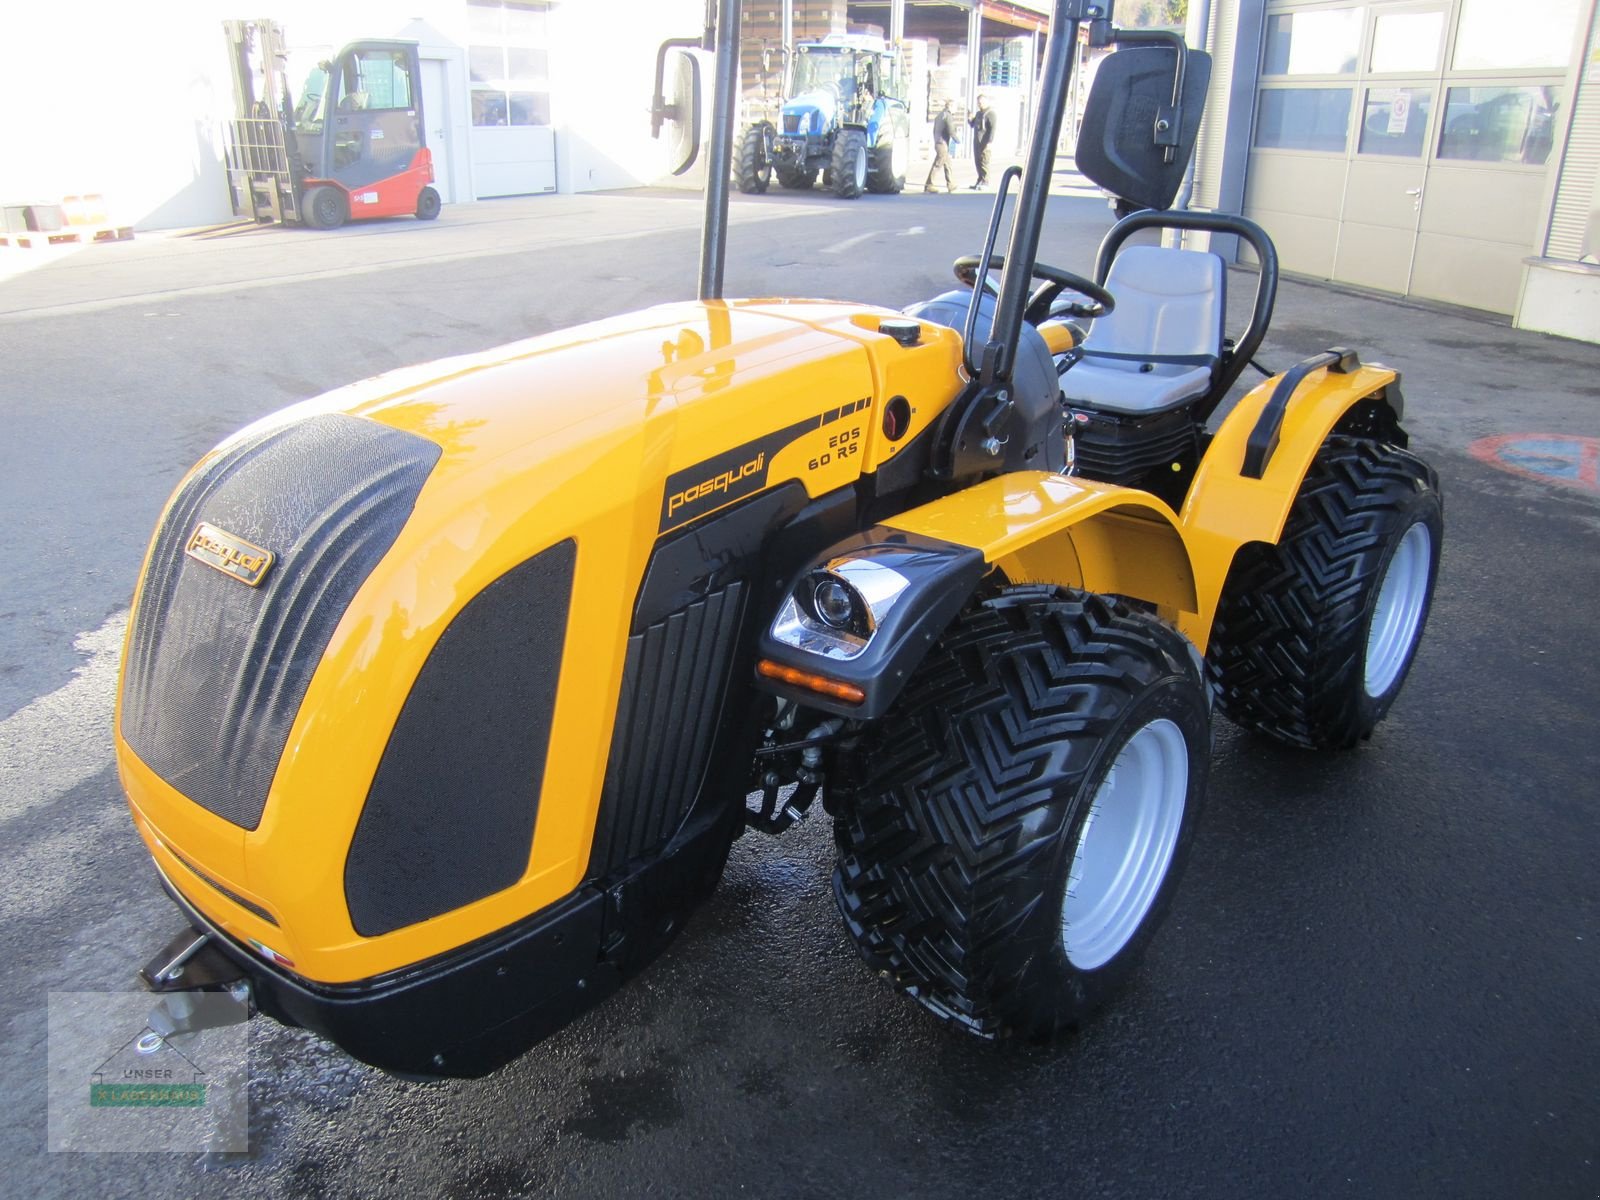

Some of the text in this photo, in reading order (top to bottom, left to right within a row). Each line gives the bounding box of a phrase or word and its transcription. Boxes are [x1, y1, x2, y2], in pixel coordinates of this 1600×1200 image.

[829, 427, 860, 448] EOS
[808, 442, 858, 470] 60 RS
[668, 452, 765, 518] pasquali
[189, 535, 265, 573] pasquali
